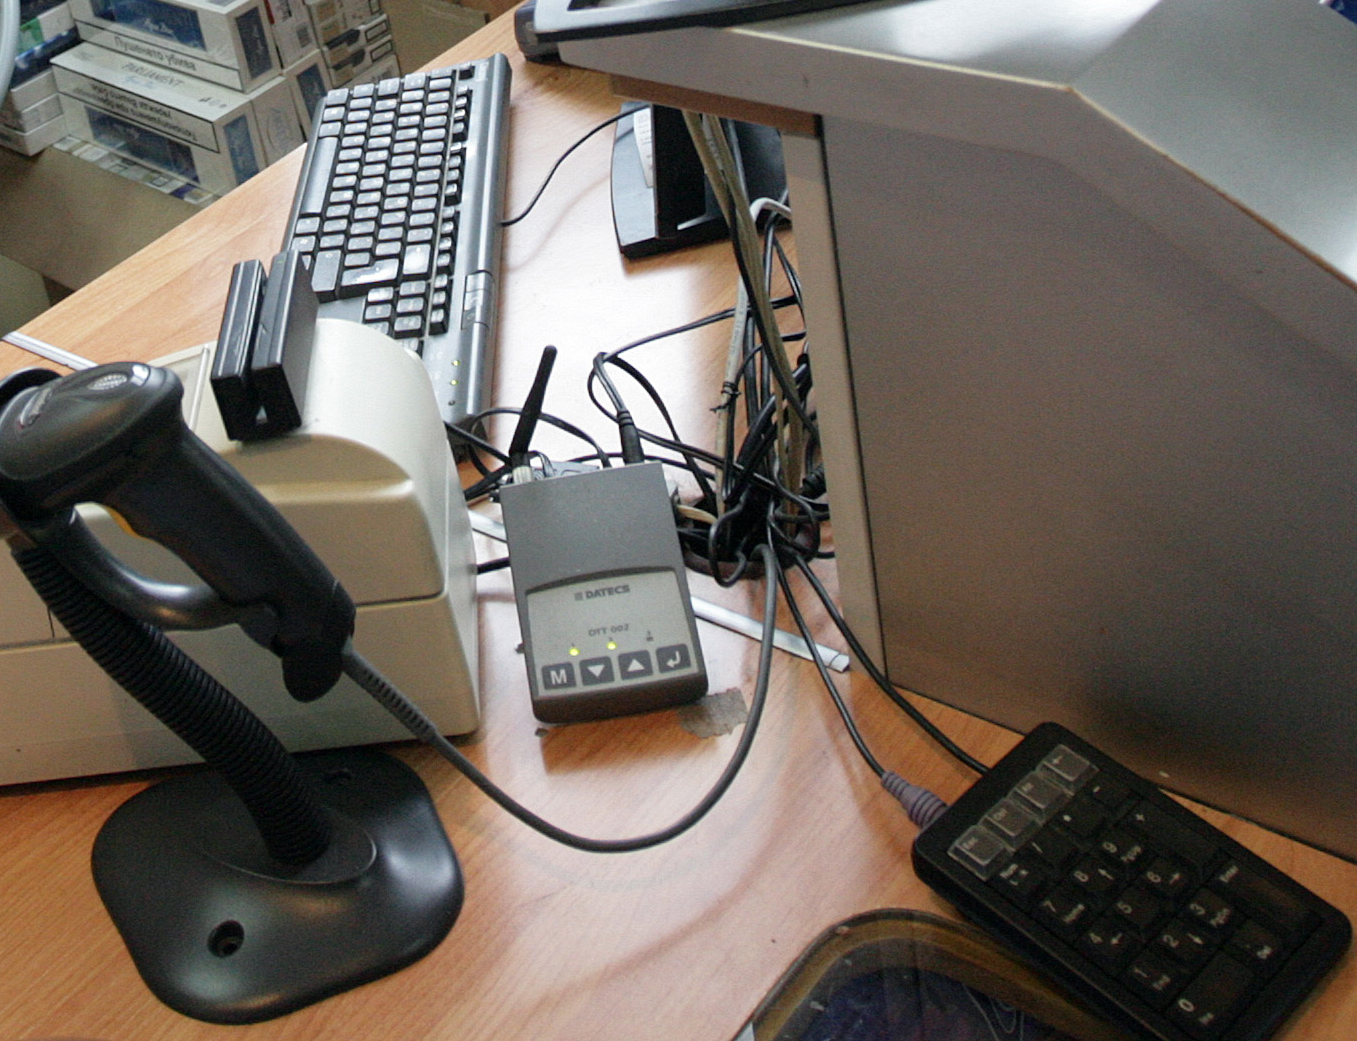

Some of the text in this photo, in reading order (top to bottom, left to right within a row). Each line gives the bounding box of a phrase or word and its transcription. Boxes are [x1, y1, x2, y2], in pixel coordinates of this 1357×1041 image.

[585, 584, 631, 600] DATECS
[549, 668, 568, 685] M
[1102, 841, 1117, 853] 9
[1074, 870, 1089, 883] 8
[1146, 871, 1162, 883] 6
[1116, 901, 1132, 914] 5
[1190, 903, 1205, 916] 3
[1163, 934, 1179, 948] 2
[1178, 998, 1194, 1013] 0
